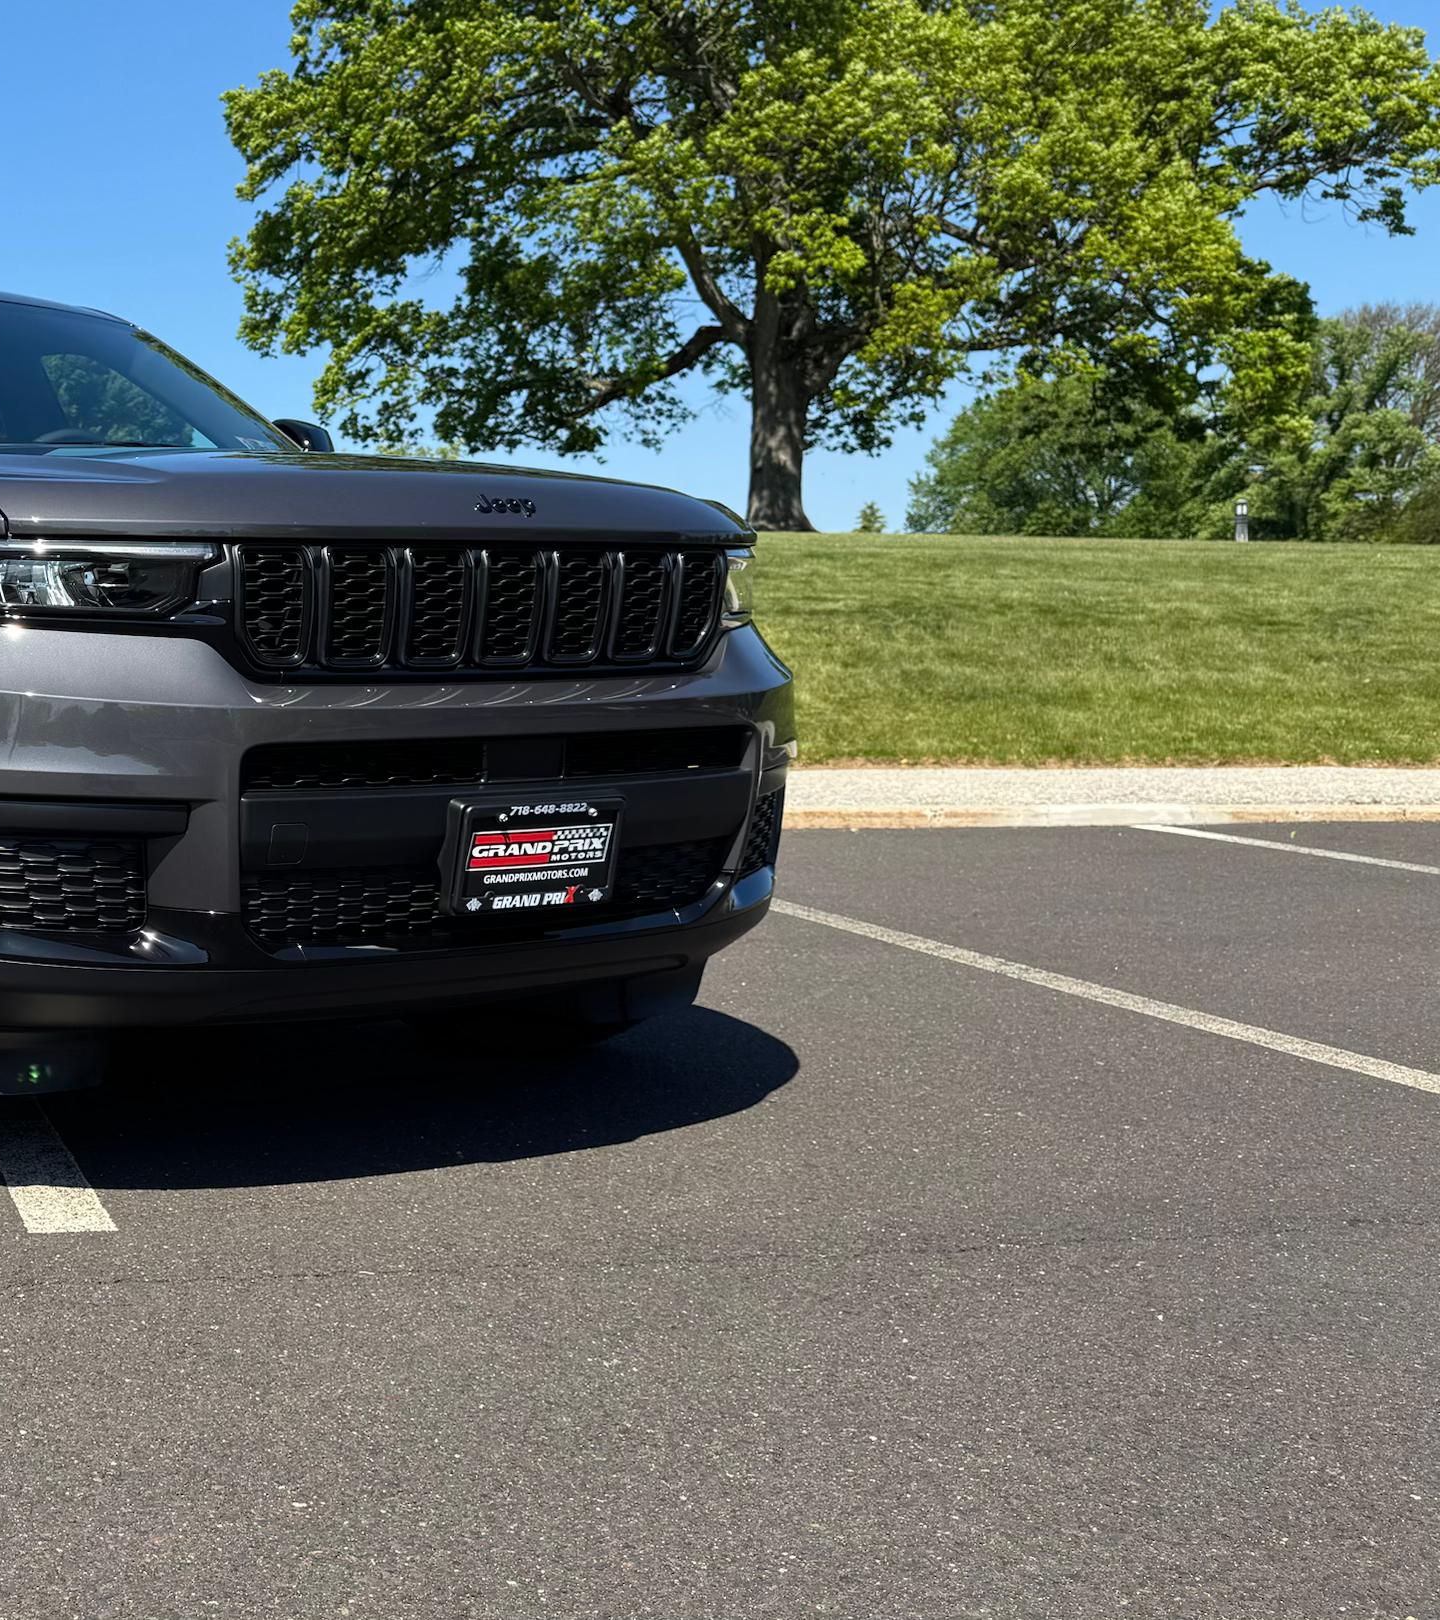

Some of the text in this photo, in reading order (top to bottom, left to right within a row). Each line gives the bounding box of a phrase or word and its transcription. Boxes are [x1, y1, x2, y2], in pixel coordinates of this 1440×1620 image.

[473, 494, 537, 518] Jeep
[510, 803, 587, 816] 718-648-8822
[472, 838, 605, 857] GRAND PRIX
[550, 851, 603, 861] MOTORS
[483, 868, 588, 884] GRANDPRIXMOTORS.COM
[492, 885, 577, 910] GRAND PRIX
